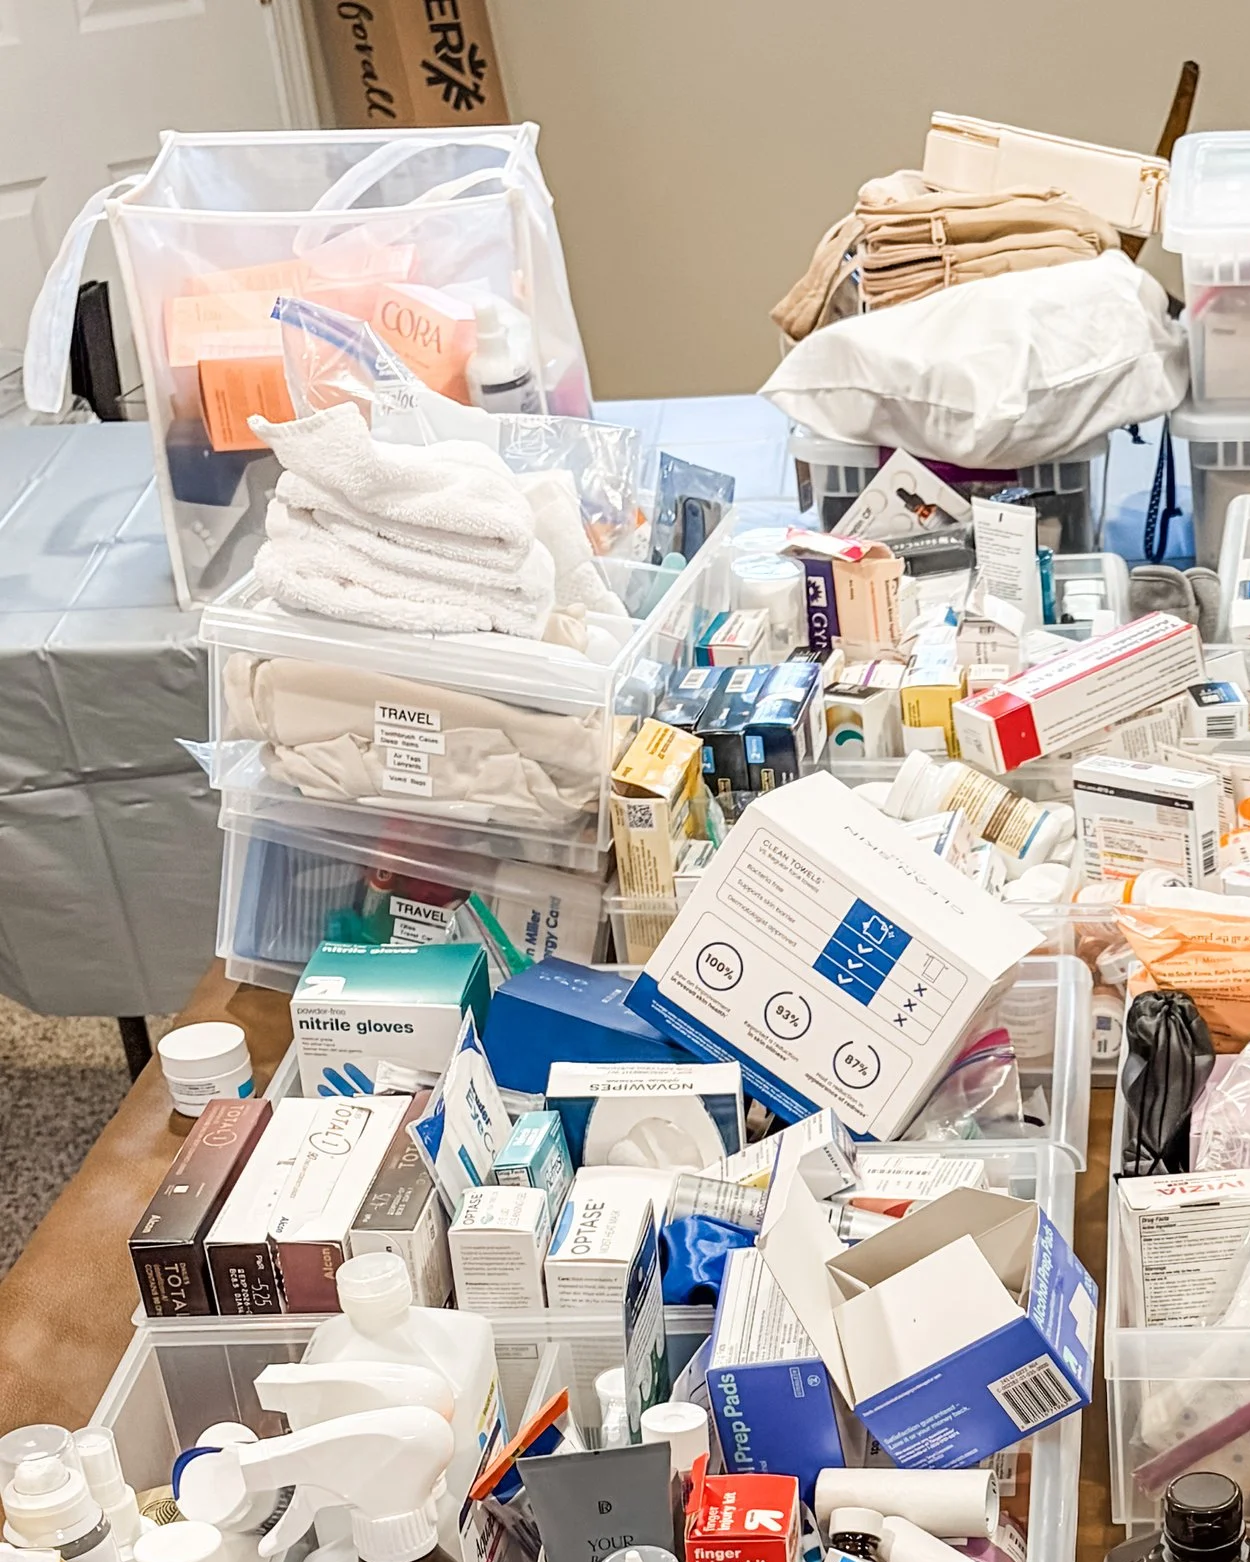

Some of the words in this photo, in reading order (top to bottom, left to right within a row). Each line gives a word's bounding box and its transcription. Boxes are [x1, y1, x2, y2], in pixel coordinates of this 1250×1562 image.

[382, 300, 442, 354] CORA
[380, 706, 433, 725] TRAVEL
[396, 902, 447, 923] TRAVEL
[704, 953, 733, 980] 100%
[299, 1017, 350, 1031] nitrile
[356, 1020, 414, 1034] gloves
[775, 1005, 799, 1028] 93%
[844, 1053, 867, 1076] 87%
[589, 1082, 694, 1092] NOVAWIPES
[463, 1193, 483, 1225] OPTASE
[571, 1201, 605, 1255] OPTASE
[323, 1247, 337, 1280] Alcon
[718, 1373, 743, 1418] Pads
[731, 1421, 753, 1463] Prep
[587, 1535, 635, 1551] YOUR
[694, 1548, 742, 1560] finger
